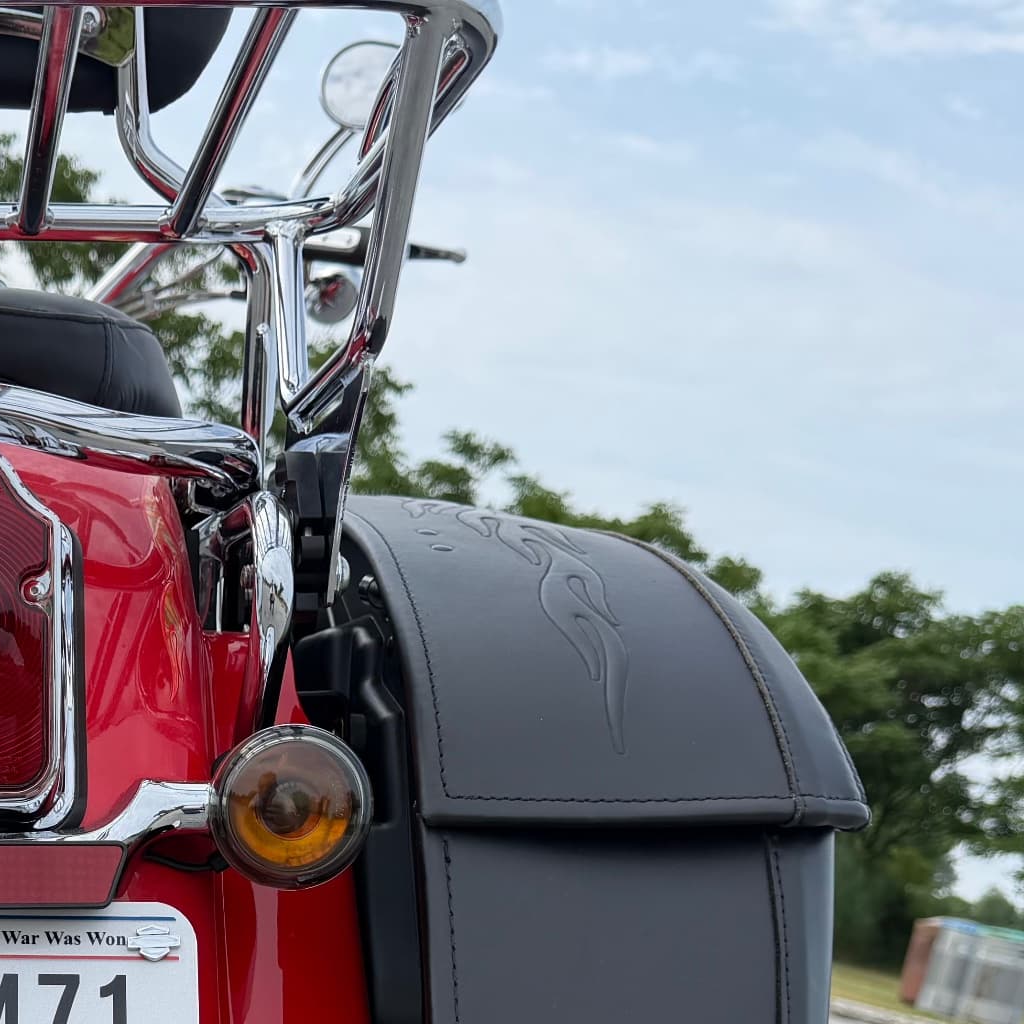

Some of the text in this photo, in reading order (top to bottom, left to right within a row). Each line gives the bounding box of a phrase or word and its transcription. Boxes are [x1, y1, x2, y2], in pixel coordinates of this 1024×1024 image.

[3, 929, 40, 946] War
[45, 930, 81, 946] Was
[86, 931, 126, 946] Won
